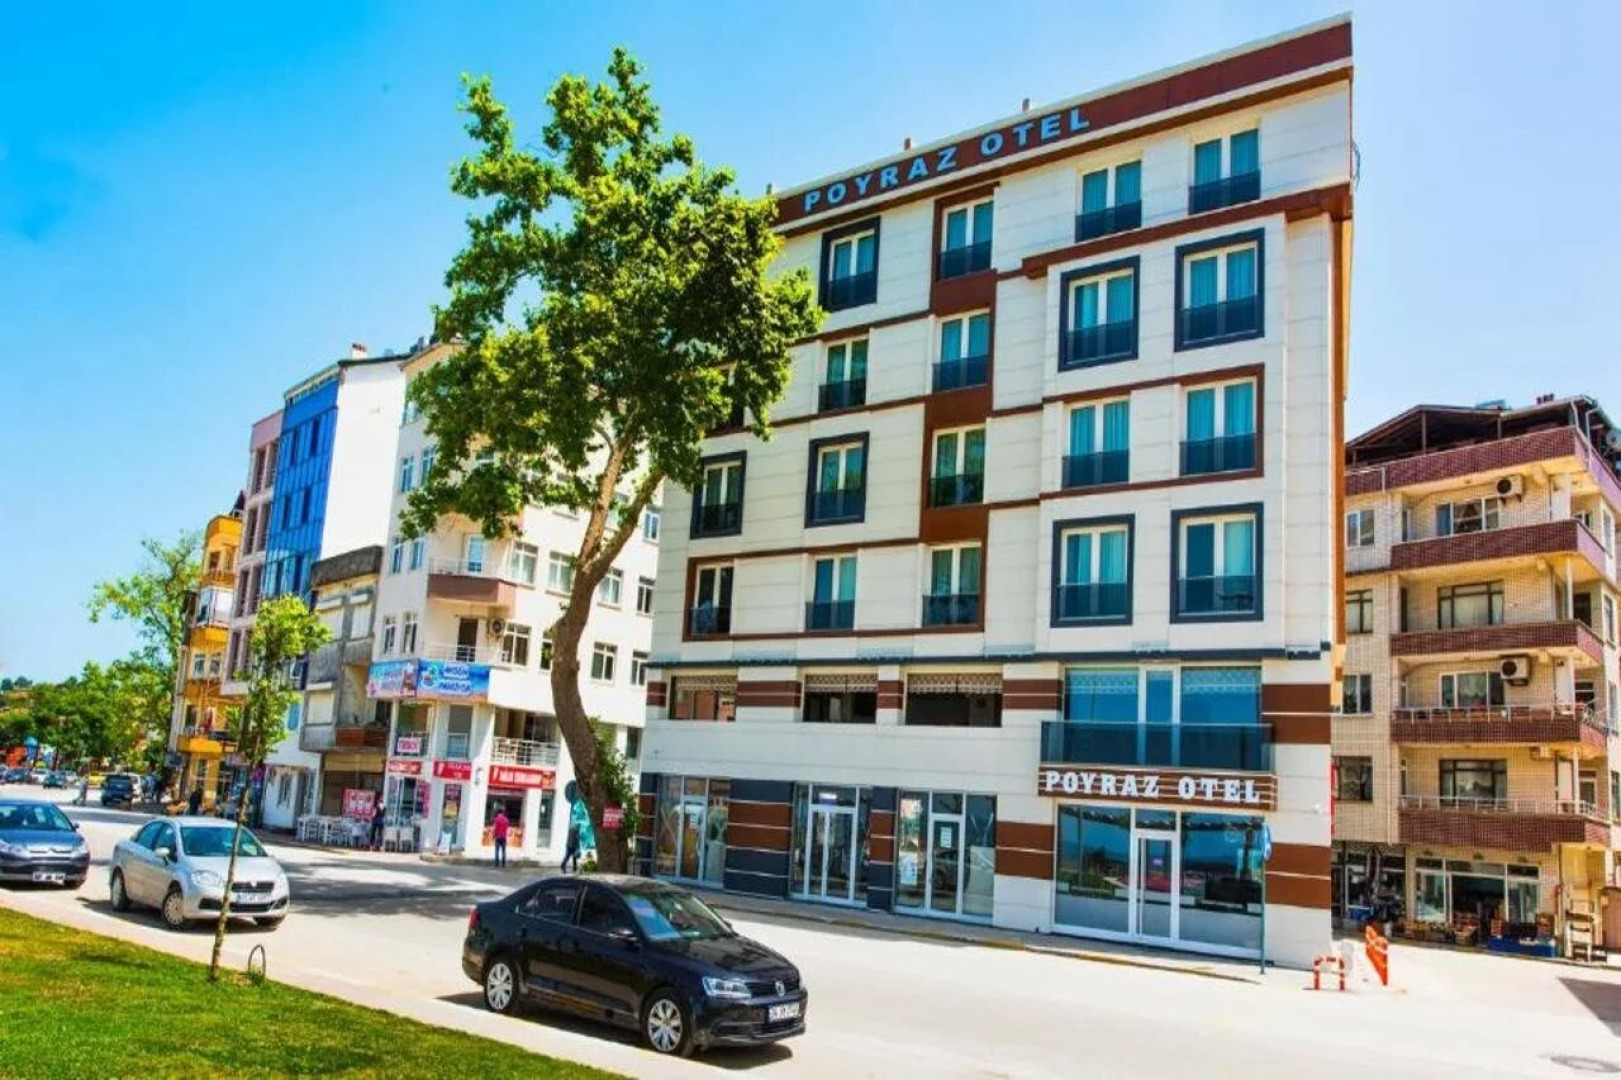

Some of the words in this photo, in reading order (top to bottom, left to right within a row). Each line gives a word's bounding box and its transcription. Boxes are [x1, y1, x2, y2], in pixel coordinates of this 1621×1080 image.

[804, 146, 957, 213] POYRAZ
[980, 108, 1090, 156] OTEL
[1045, 771, 1160, 798] POYRAZ
[1178, 778, 1260, 803] OTEL
